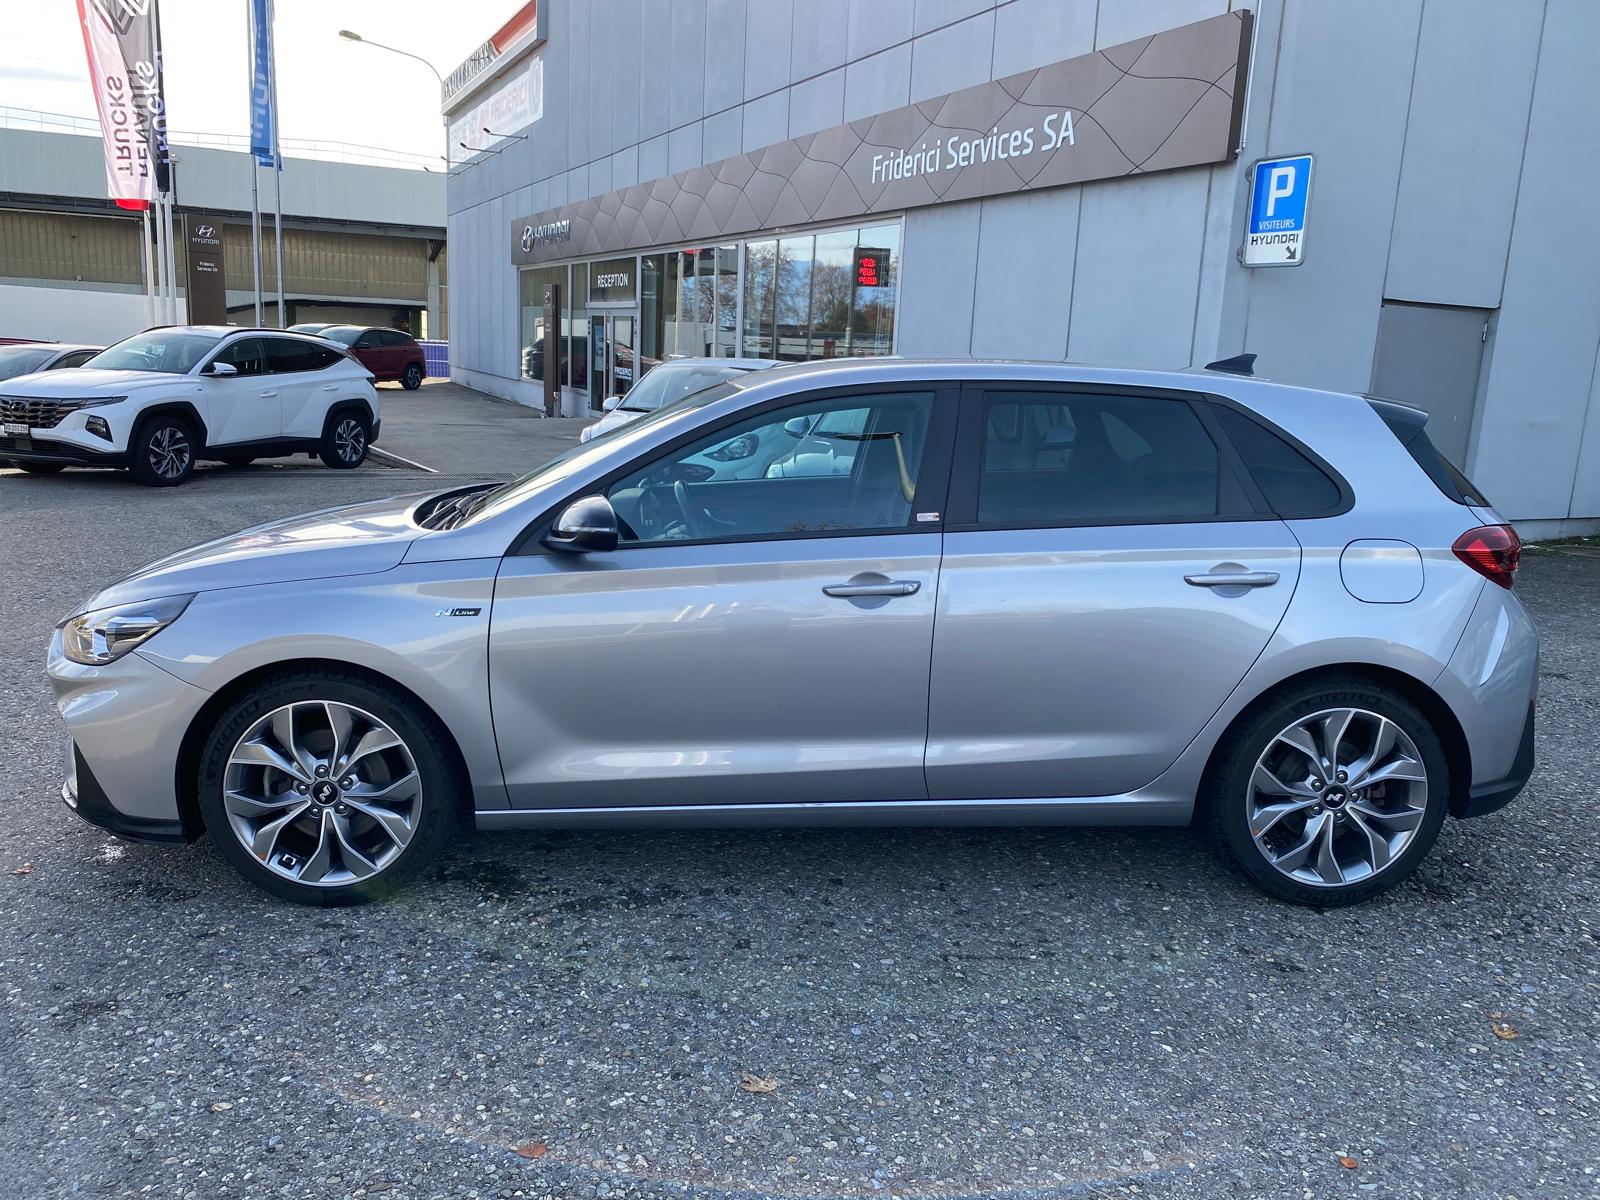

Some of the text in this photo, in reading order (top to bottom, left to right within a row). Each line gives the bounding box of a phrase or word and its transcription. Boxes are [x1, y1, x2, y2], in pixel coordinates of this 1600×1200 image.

[871, 111, 1076, 184] Friderici Services SA
[1266, 166, 1296, 217] P
[1258, 218, 1295, 230] VISITEURS
[192, 237, 219, 245] HYUNDAI
[1250, 233, 1299, 246] HYUNDAI
[597, 273, 629, 288] RECEPTION
